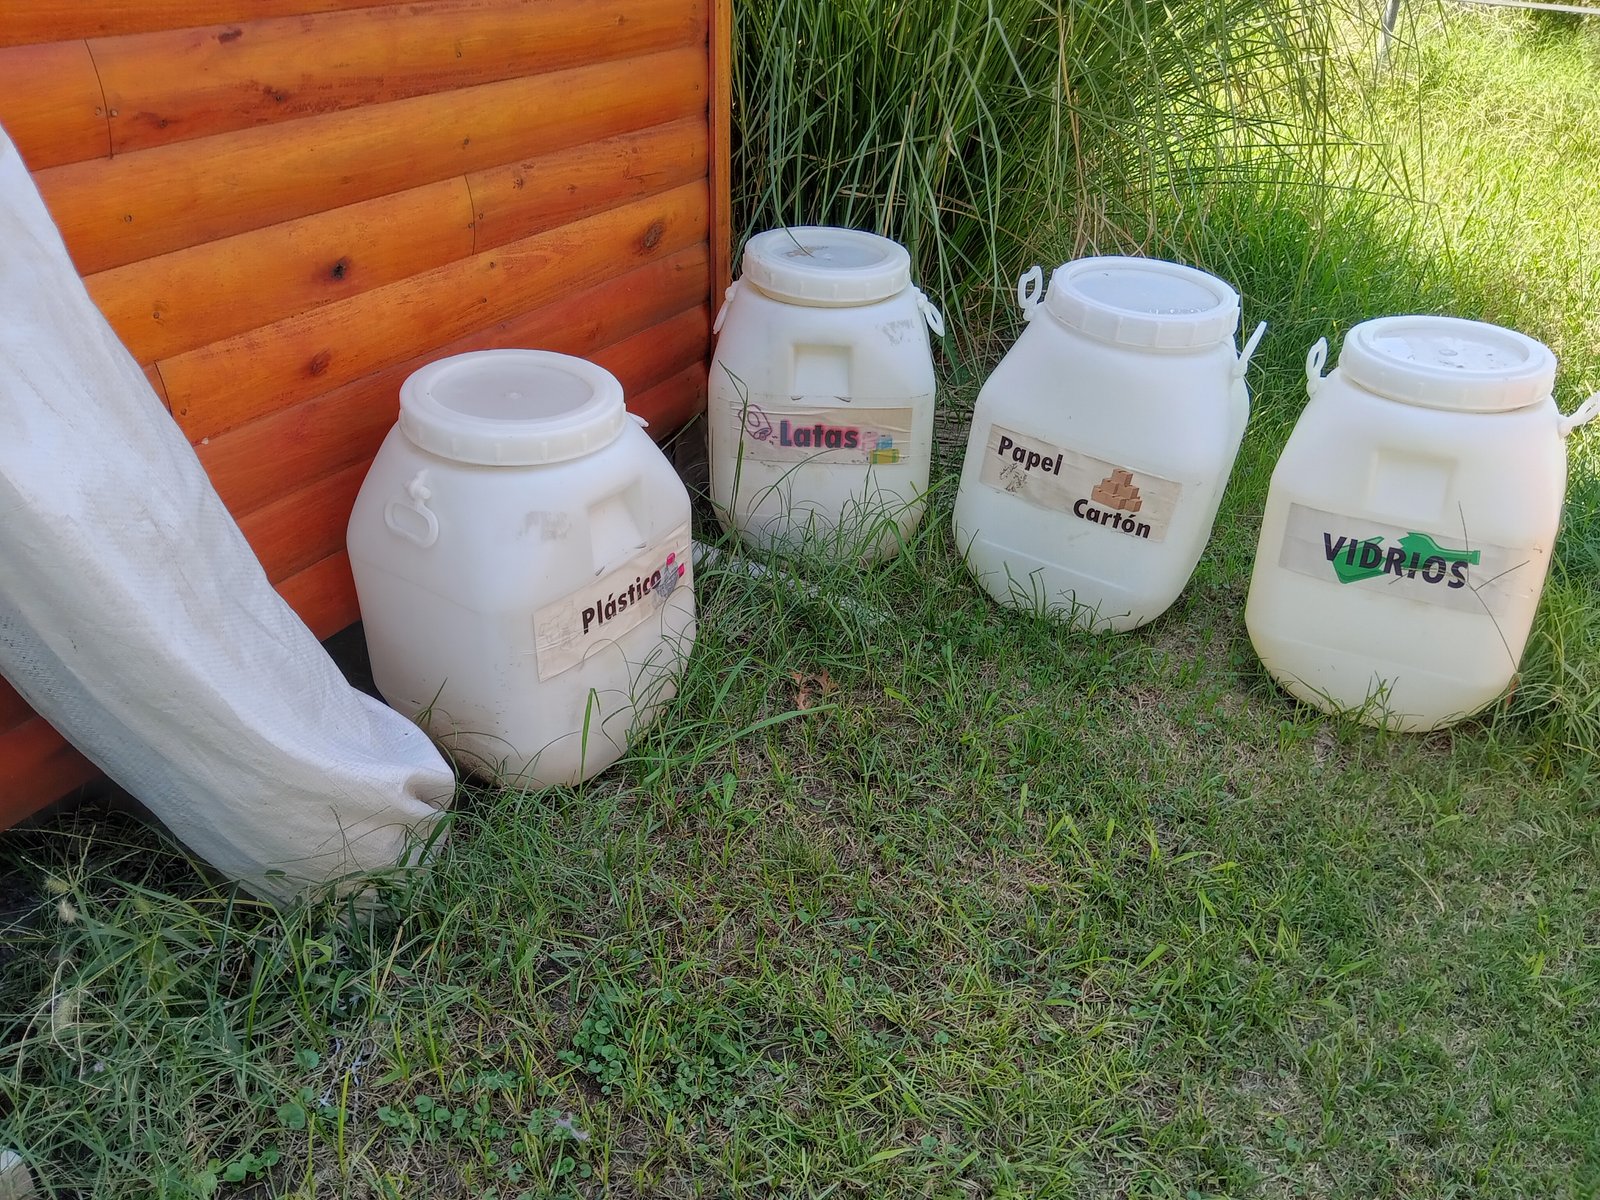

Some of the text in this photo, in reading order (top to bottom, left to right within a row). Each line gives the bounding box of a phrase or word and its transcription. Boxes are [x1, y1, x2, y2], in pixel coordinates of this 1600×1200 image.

[780, 420, 859, 448] Latas
[998, 436, 1063, 476] Papel
[1073, 499, 1150, 538] Cartón
[1323, 532, 1469, 589] VIDRIOS
